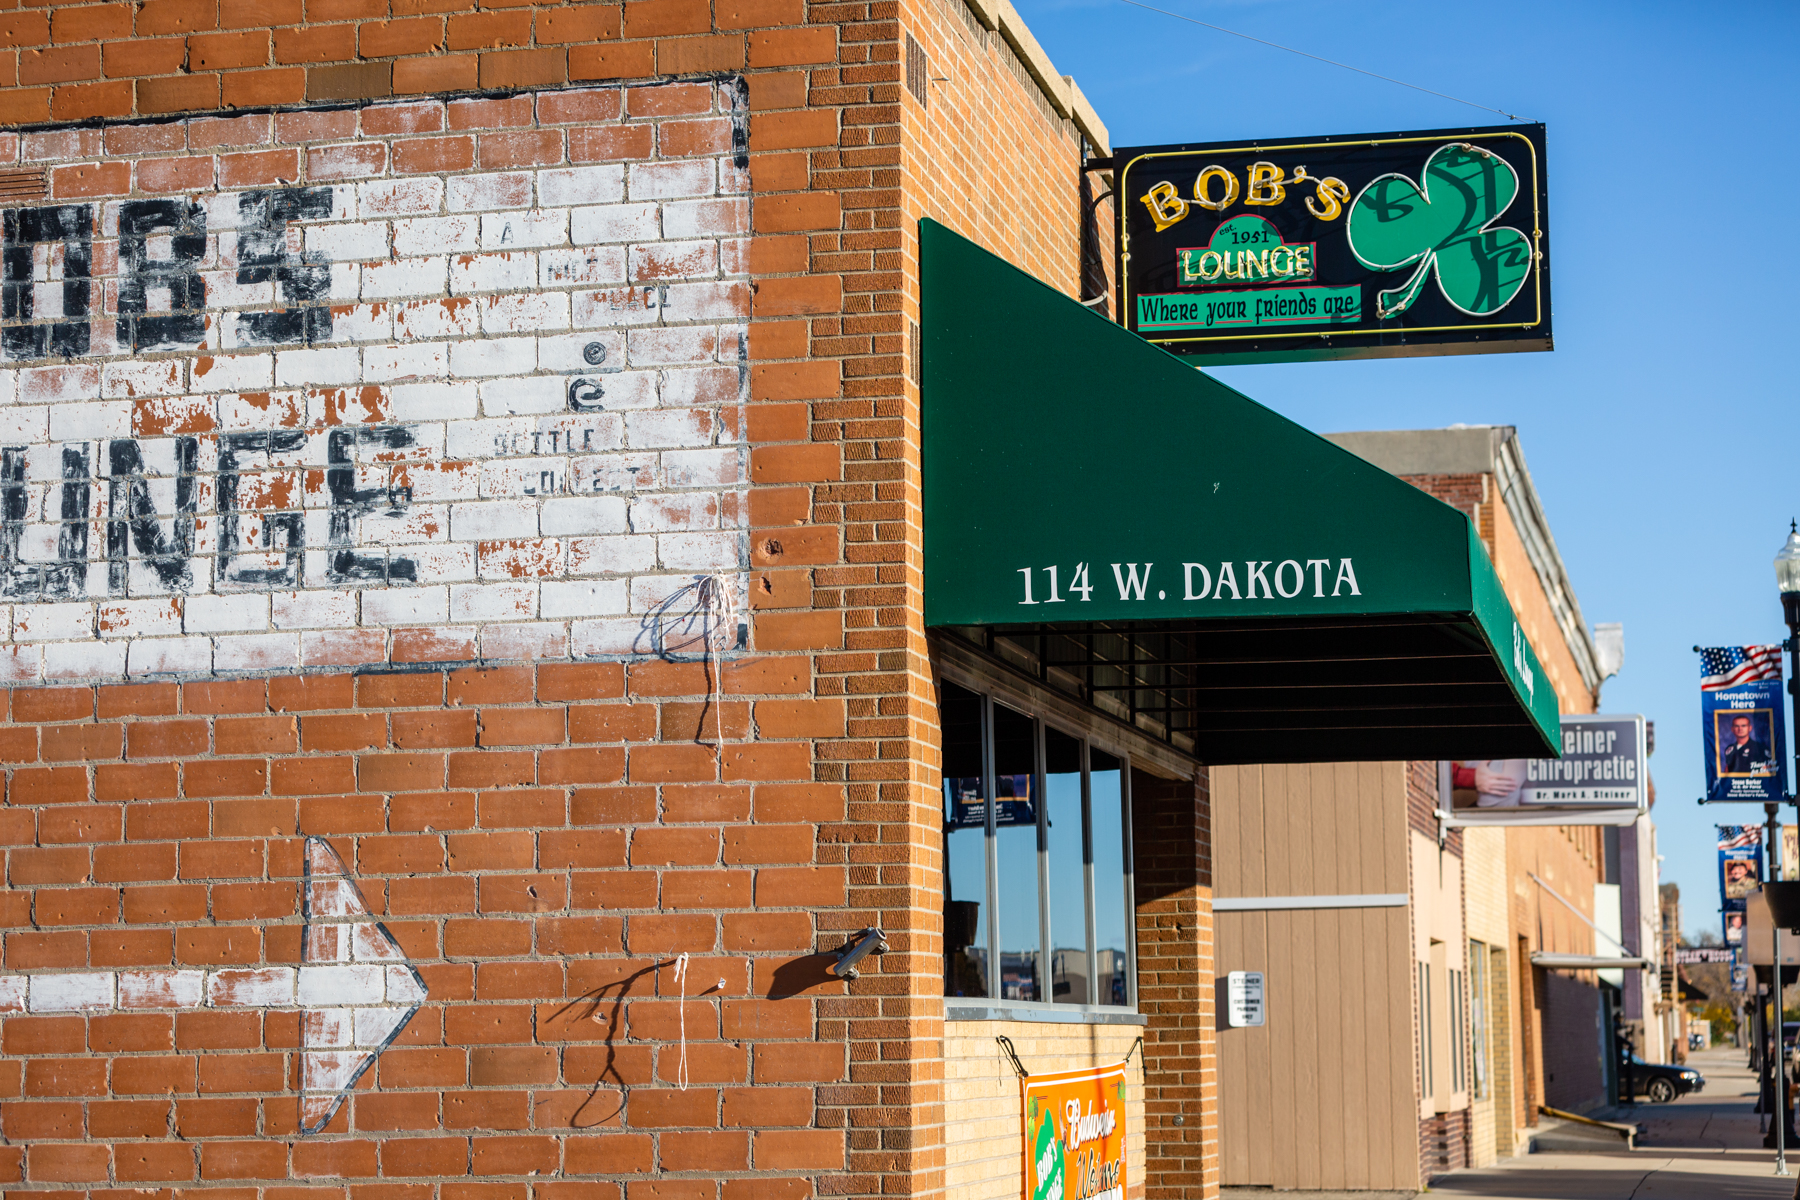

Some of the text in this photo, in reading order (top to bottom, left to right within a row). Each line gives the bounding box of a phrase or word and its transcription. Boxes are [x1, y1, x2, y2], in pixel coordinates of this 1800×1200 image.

[1139, 161, 1351, 233] BOB'S
[1232, 230, 1269, 245] 1951
[1181, 245, 1313, 282] LOUNGE
[1141, 291, 1355, 327] Where your friends are
[1016, 558, 1362, 604] 114 W. DAKOTA
[1715, 691, 1770, 701] Hometown
[1730, 700, 1755, 709] Hero
[1560, 726, 1617, 755] teiner
[1527, 755, 1635, 784] Chiropractic
[1553, 790, 1577, 799] Mark
[1594, 790, 1631, 799] Steiner
